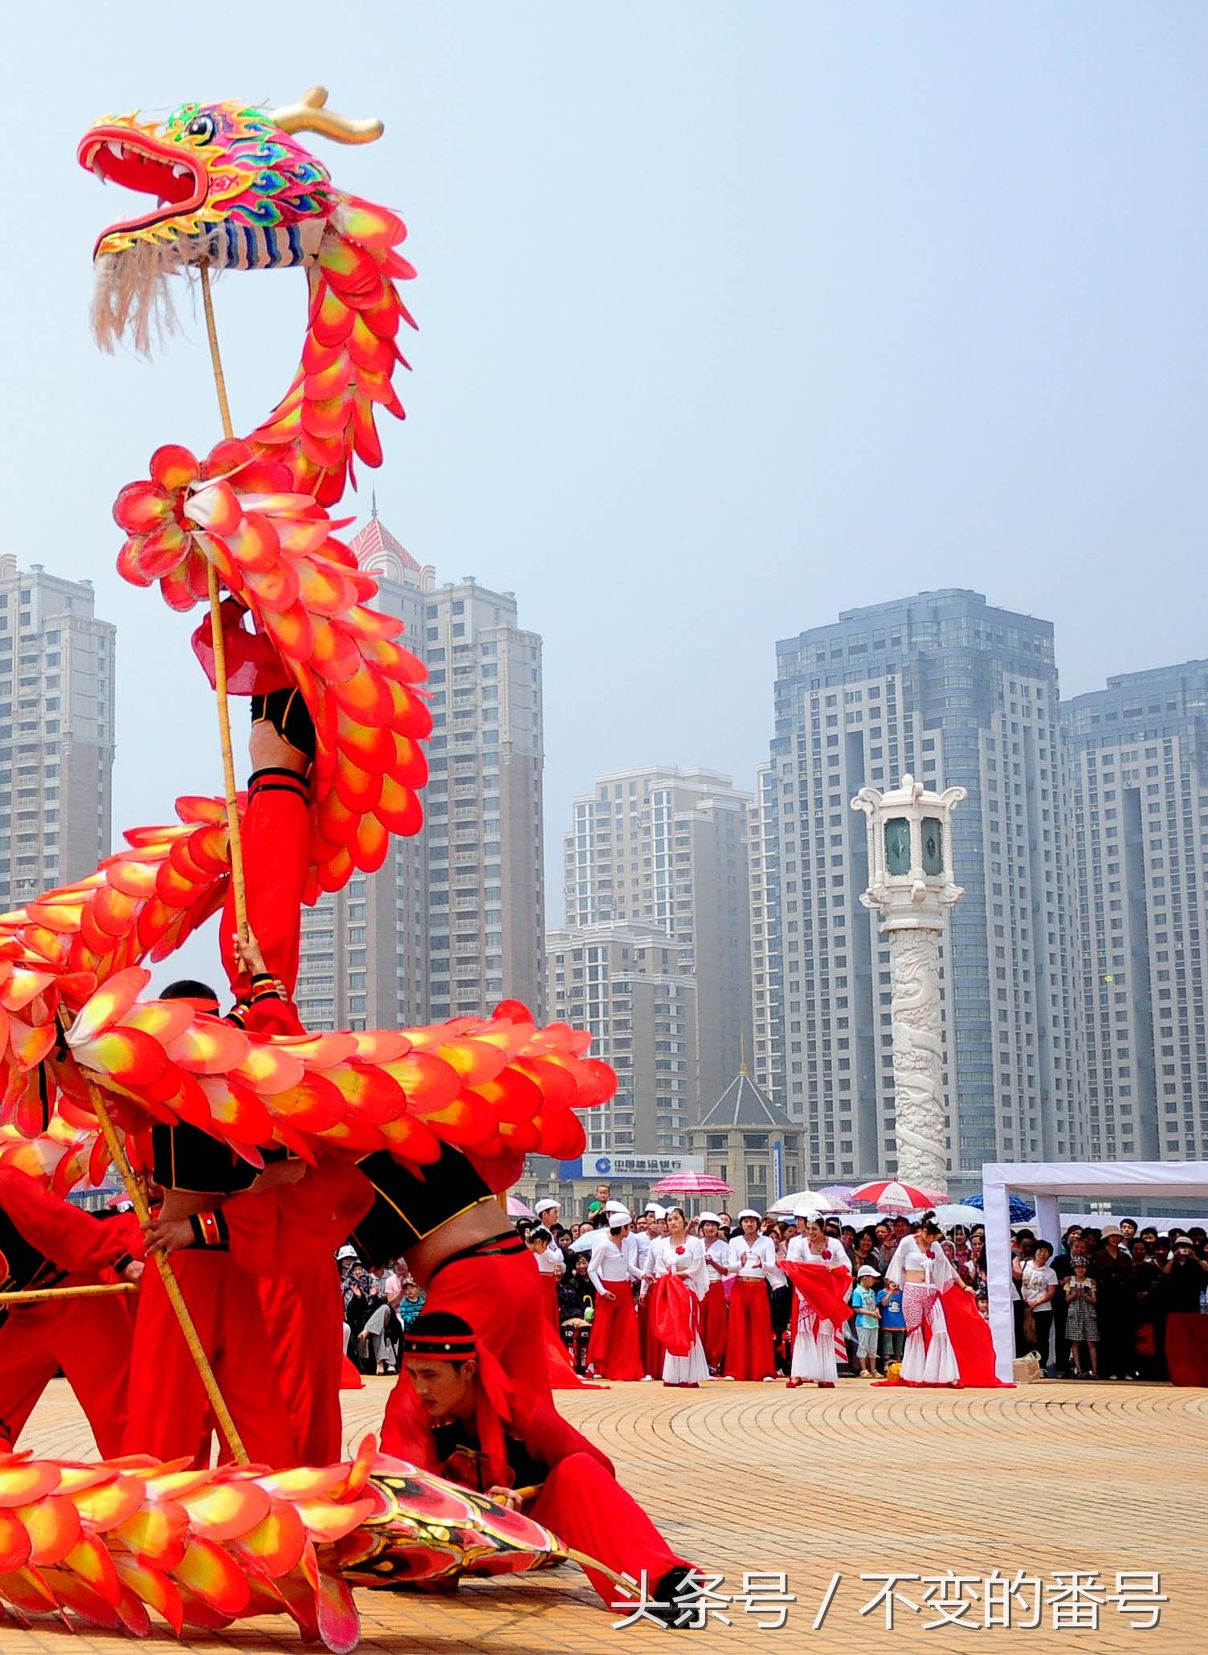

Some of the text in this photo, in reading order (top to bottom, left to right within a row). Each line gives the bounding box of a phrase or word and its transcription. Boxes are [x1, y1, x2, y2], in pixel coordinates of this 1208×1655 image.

[614, 1159, 681, 1169] 中国建设银行
